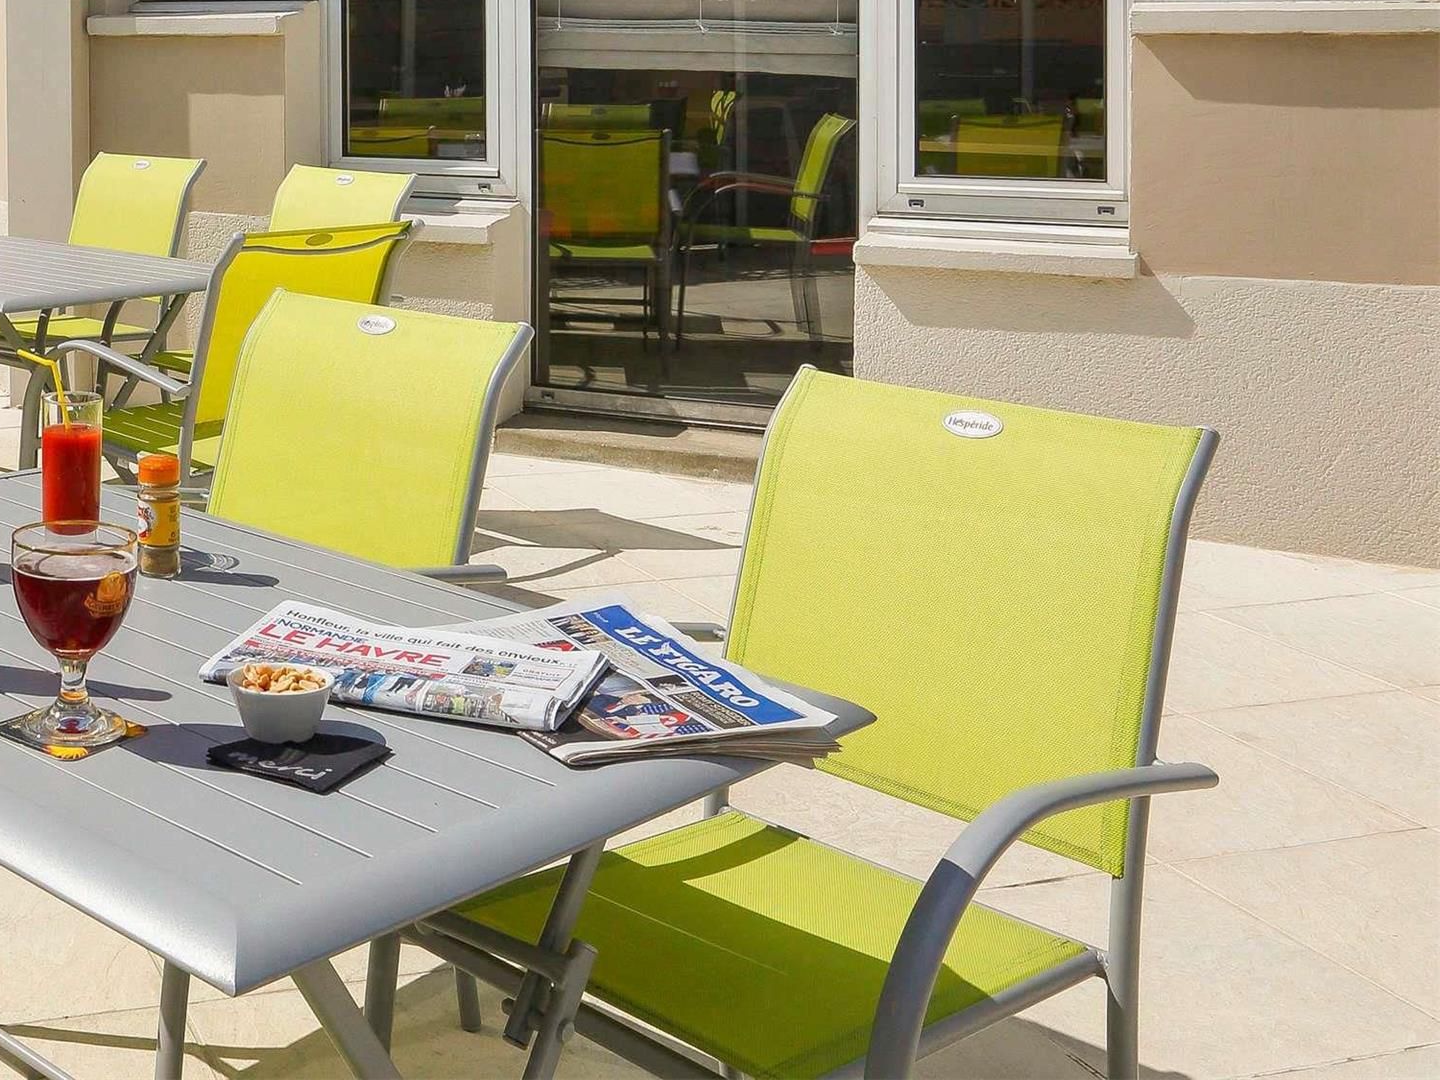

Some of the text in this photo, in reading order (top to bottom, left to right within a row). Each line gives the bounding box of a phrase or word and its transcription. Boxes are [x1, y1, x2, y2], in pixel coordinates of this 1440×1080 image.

[259, 623, 314, 645] LE
[316, 637, 451, 667] HAVRE
[277, 619, 368, 644] NORMANDIE
[286, 609, 350, 632] Honfleur,
[373, 629, 404, 642] ville
[407, 636, 432, 647] qui
[435, 639, 462, 650] fait
[465, 644, 495, 655] des
[498, 650, 560, 666] envieux
[614, 626, 662, 646] LE
[648, 641, 760, 708] FIGARO
